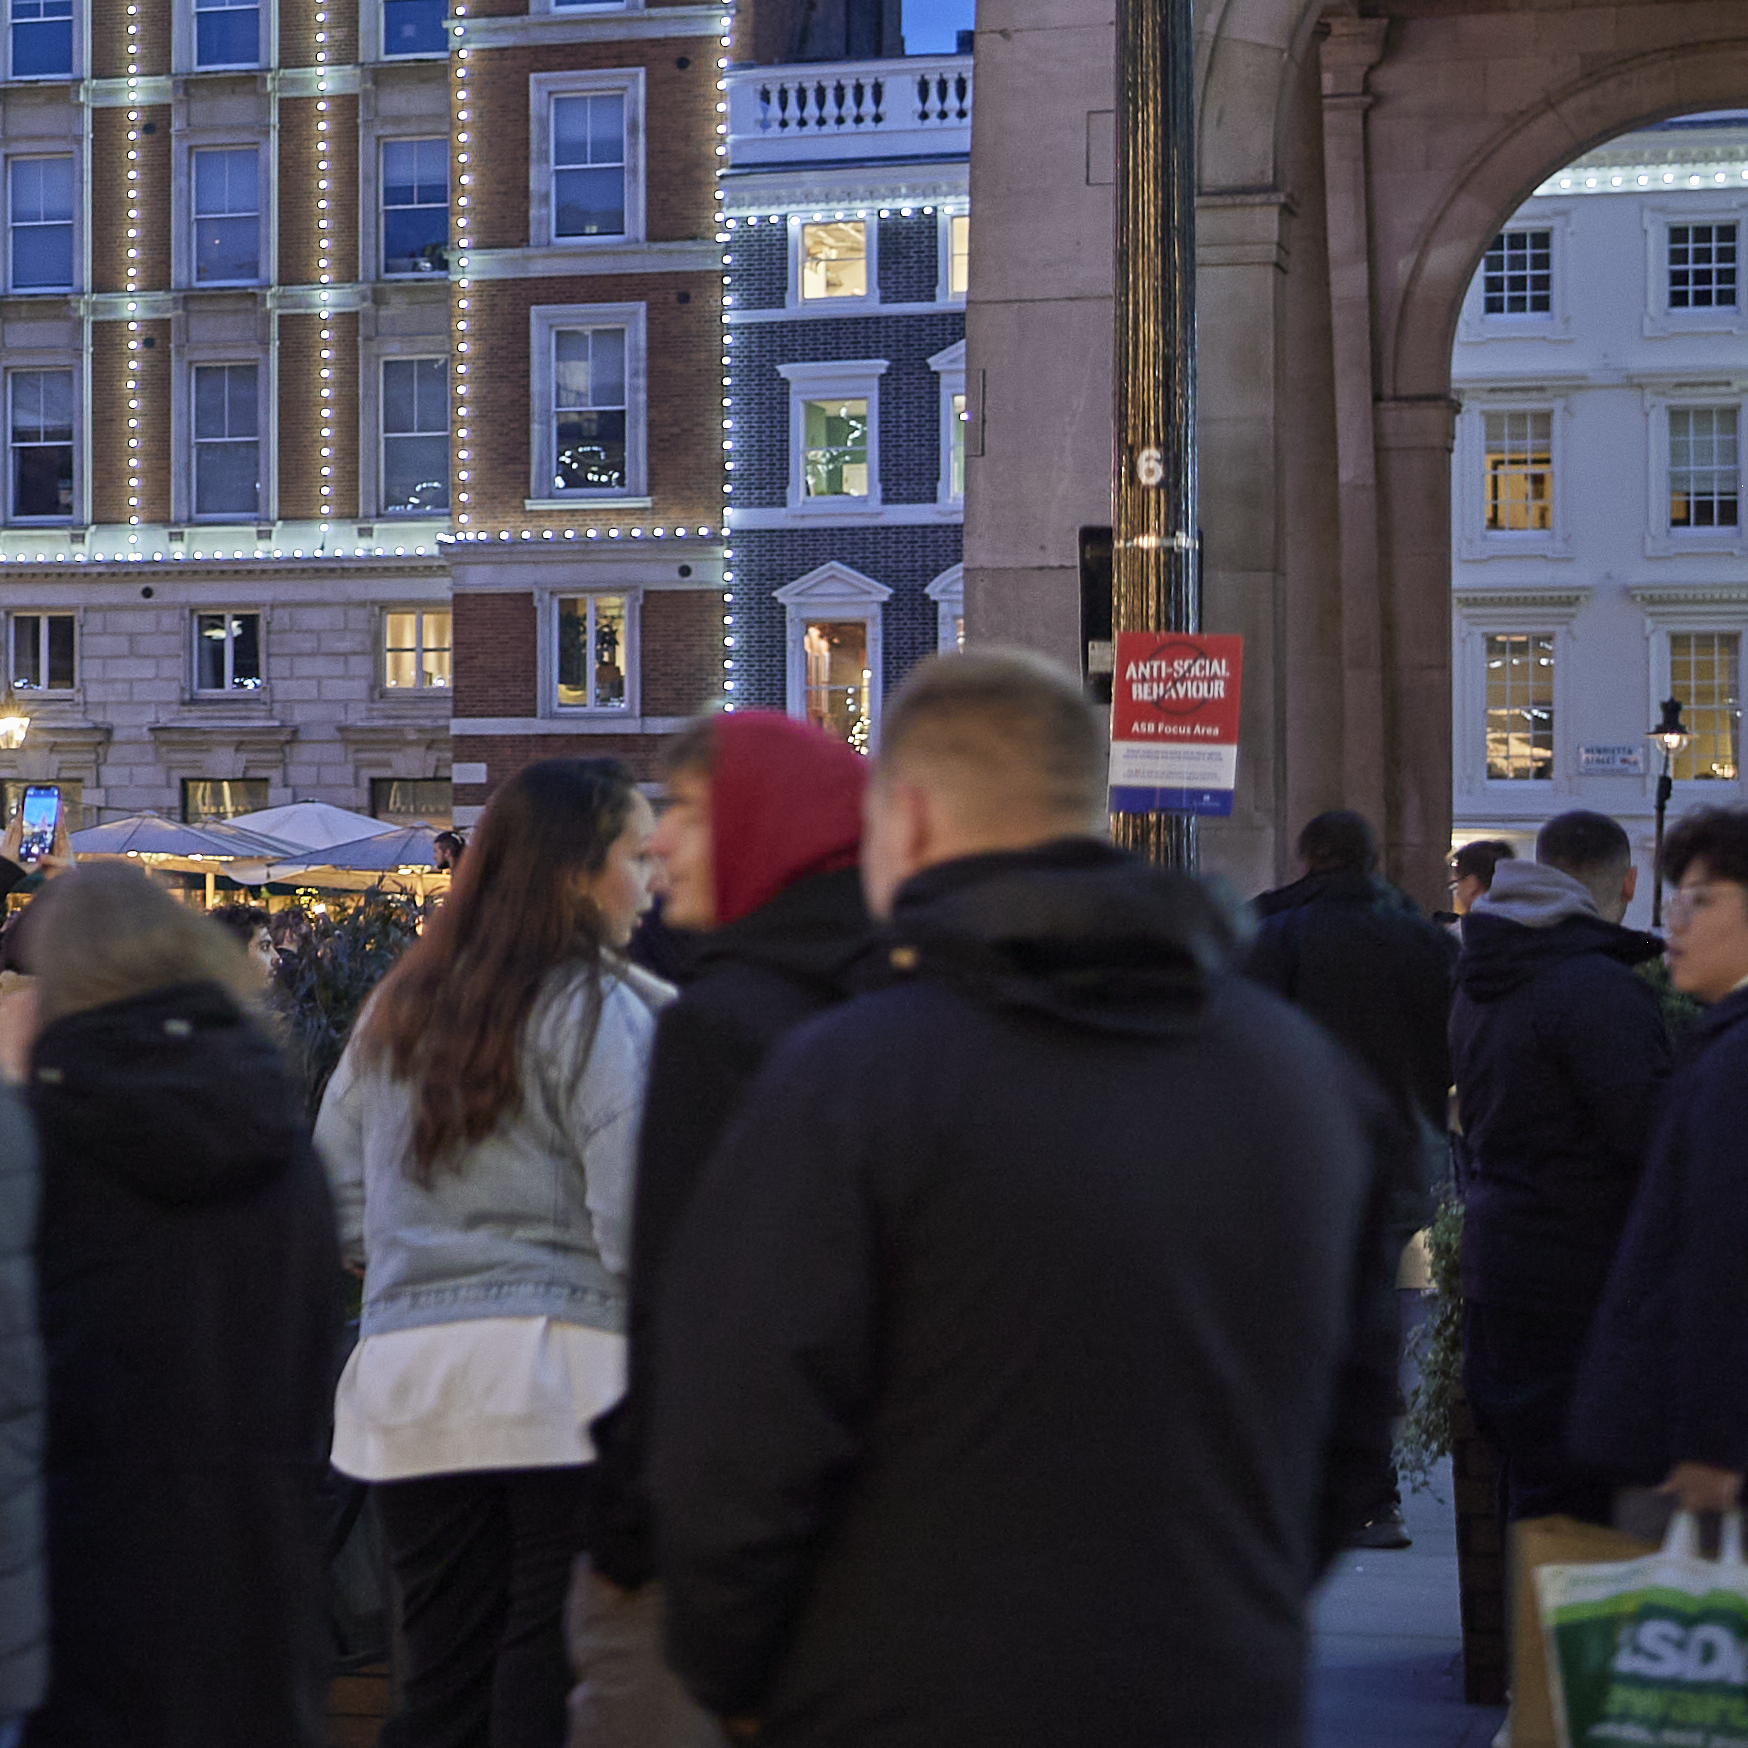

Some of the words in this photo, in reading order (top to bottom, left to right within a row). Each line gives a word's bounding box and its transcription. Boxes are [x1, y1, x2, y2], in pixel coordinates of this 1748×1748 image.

[1136, 448, 1163, 486] 6
[1125, 658, 1230, 680] ANTI-SOCIAL
[1131, 679, 1225, 701] BEHAVIOUR
[1131, 721, 1155, 734] ASB
[1158, 721, 1191, 735] Focus
[1193, 723, 1220, 737] Area
